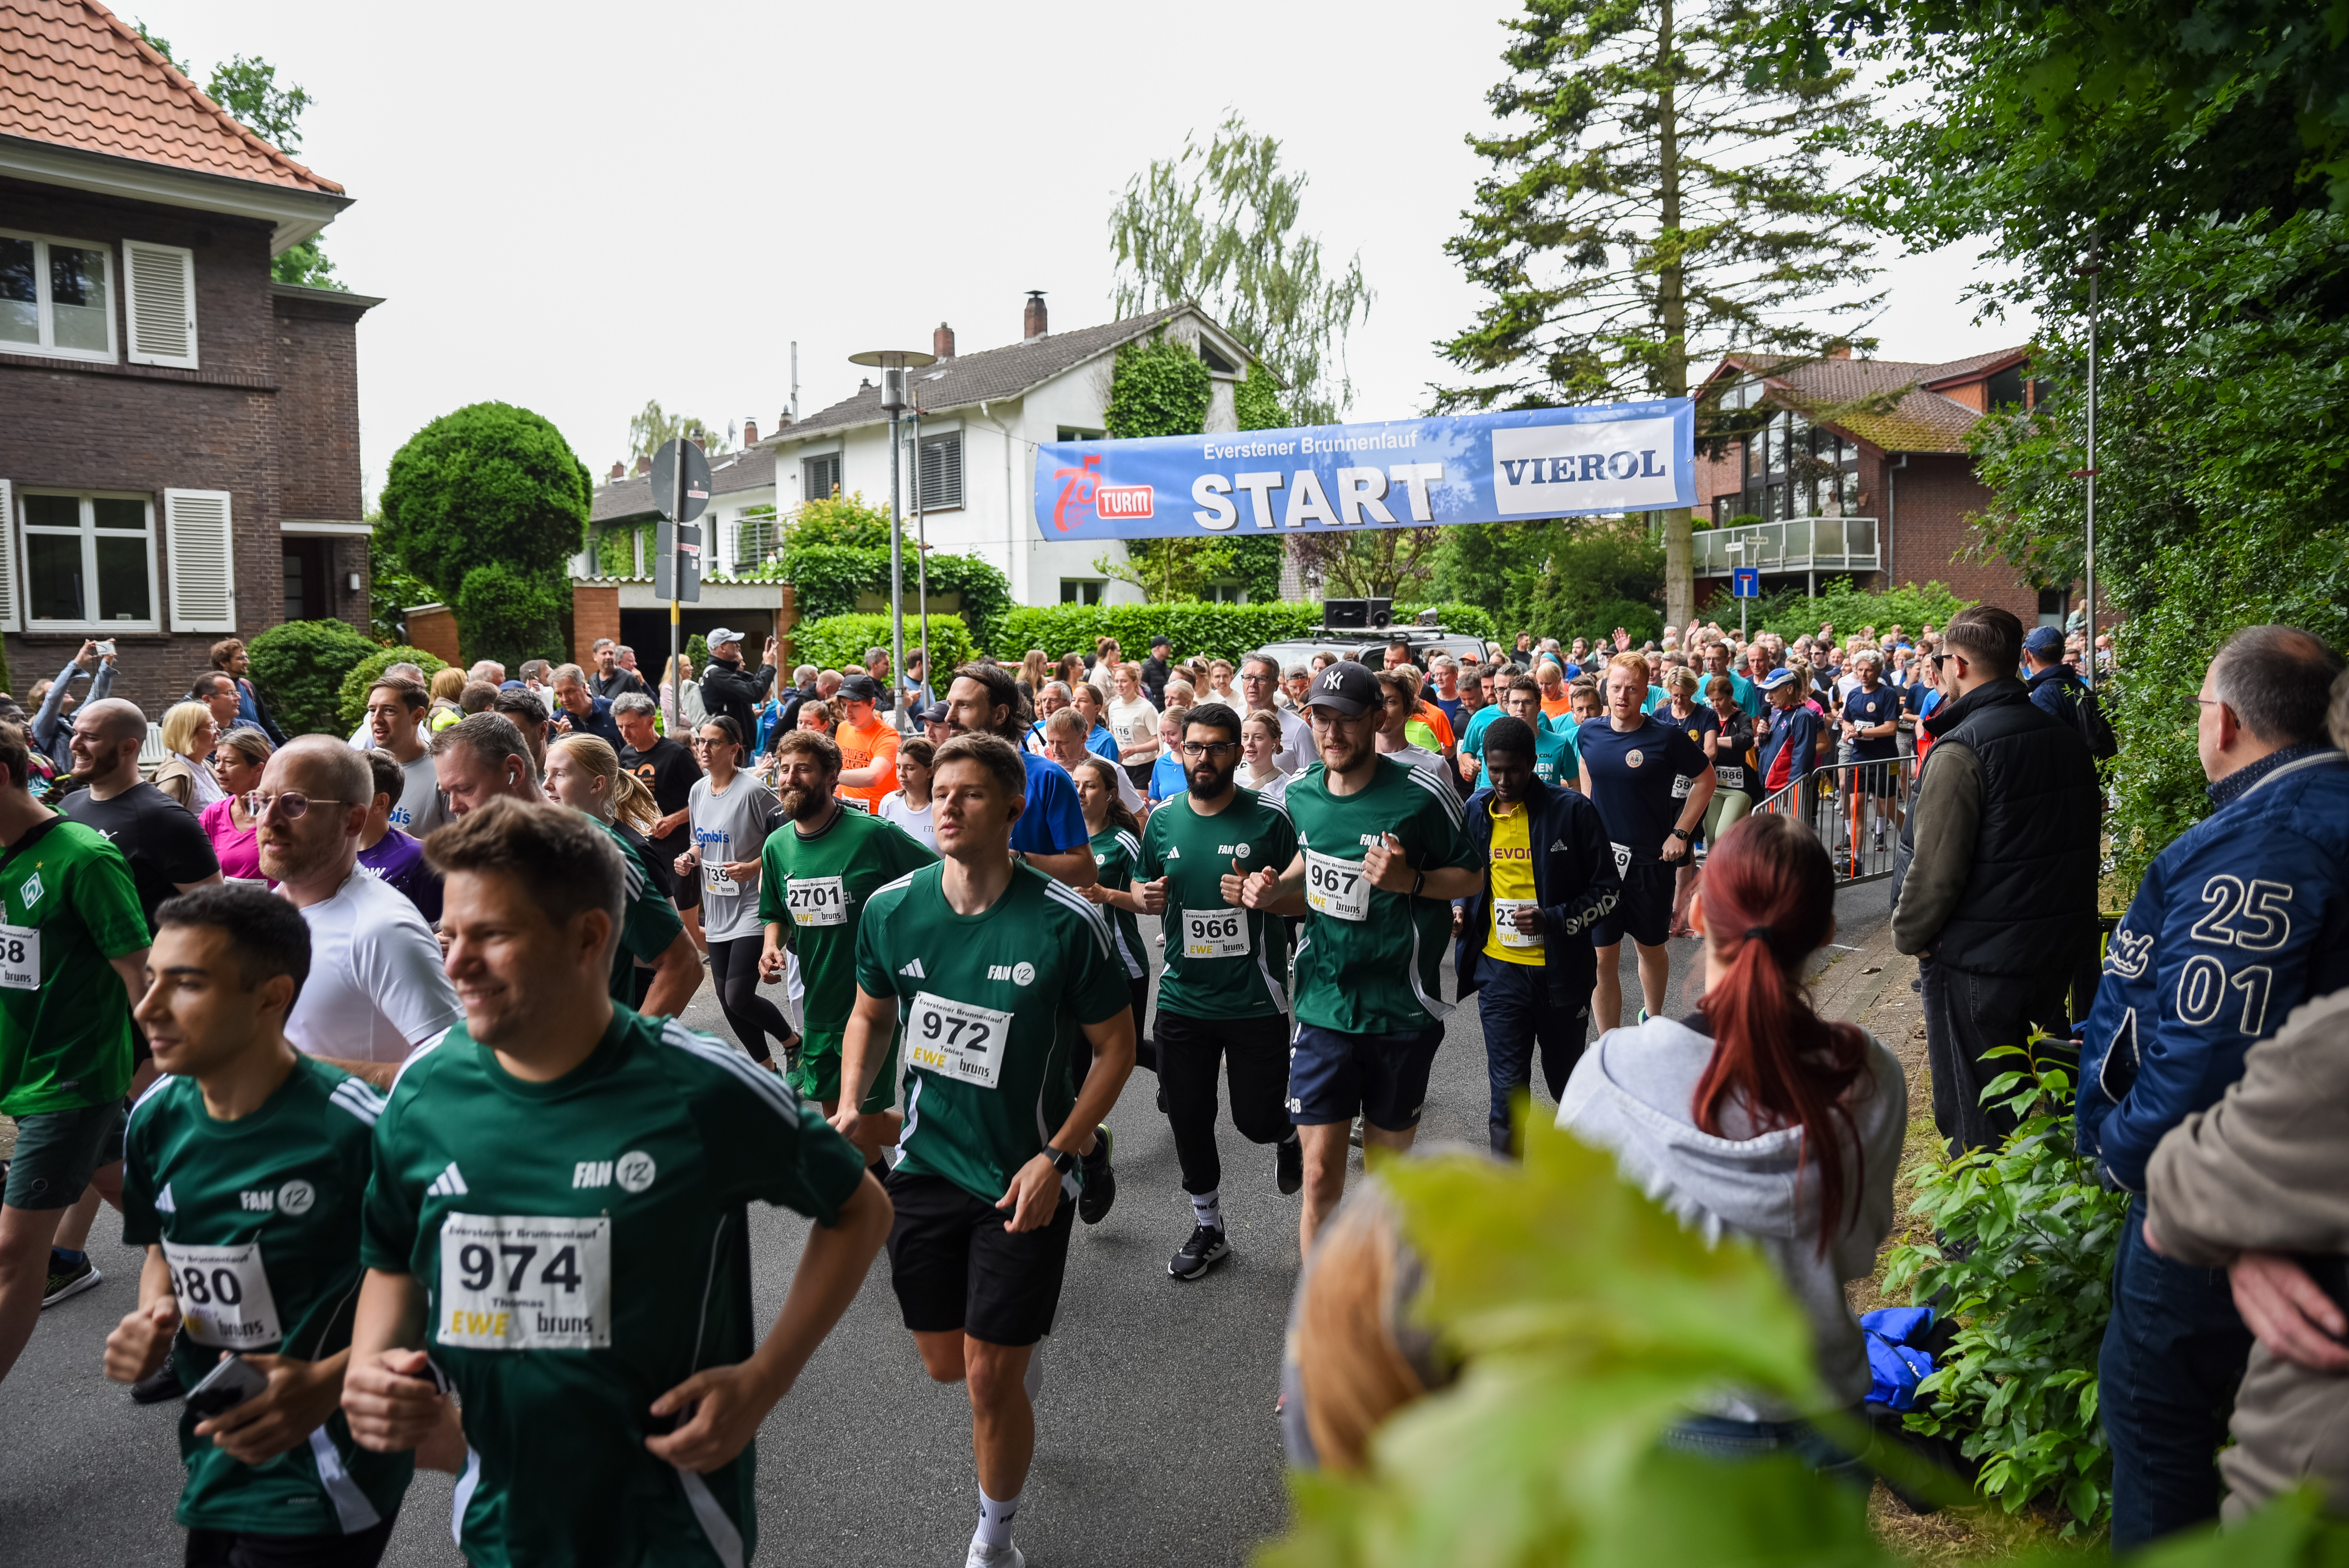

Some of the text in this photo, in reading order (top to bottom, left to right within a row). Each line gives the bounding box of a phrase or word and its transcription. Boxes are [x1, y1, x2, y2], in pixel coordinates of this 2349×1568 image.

[1203, 430, 1418, 460] Everstener Brunnenlauf
[1499, 449, 1666, 486] VIEROL
[1100, 491, 1148, 513] TURM
[1191, 462, 1445, 531] START
[1716, 770, 1742, 779] 1986
[1217, 845, 1249, 855] FAN 12
[1359, 834, 1380, 846] FAN
[1308, 854, 1367, 872] Everstener Brunnenlau
[705, 866, 729, 882] 739
[1311, 864, 1359, 895] 967
[789, 886, 839, 907] 2701
[1309, 892, 1326, 908] EWE
[1336, 900, 1360, 914] bruns
[1319, 889, 1342, 900] Christian
[796, 913, 813, 922] EWE
[822, 912, 841, 920] bruns
[2190, 873, 2293, 951] 25
[1191, 918, 1238, 939] 966
[1500, 933, 1518, 942] EWE
[1190, 945, 1213, 954] EWE
[1223, 943, 1244, 952] bruns
[5, 970, 32, 983] bruns
[987, 965, 1031, 981] FAN 12
[2176, 954, 2273, 1037] 01
[919, 998, 1003, 1025] Everstener Brunnenlauf
[922, 1011, 990, 1053] 972
[940, 1044, 964, 1057] Tobias
[914, 1047, 946, 1068] EWE
[959, 1059, 990, 1077] bruns
[1291, 1098, 1301, 1113] CB
[572, 1160, 648, 1189] FAN 12
[240, 1187, 309, 1211] FAN 12
[449, 1226, 598, 1240] Everstener Brunnenlauf
[460, 1243, 582, 1293] 974
[491, 1297, 545, 1309] Thomas
[452, 1310, 594, 1336] EWE bruns
